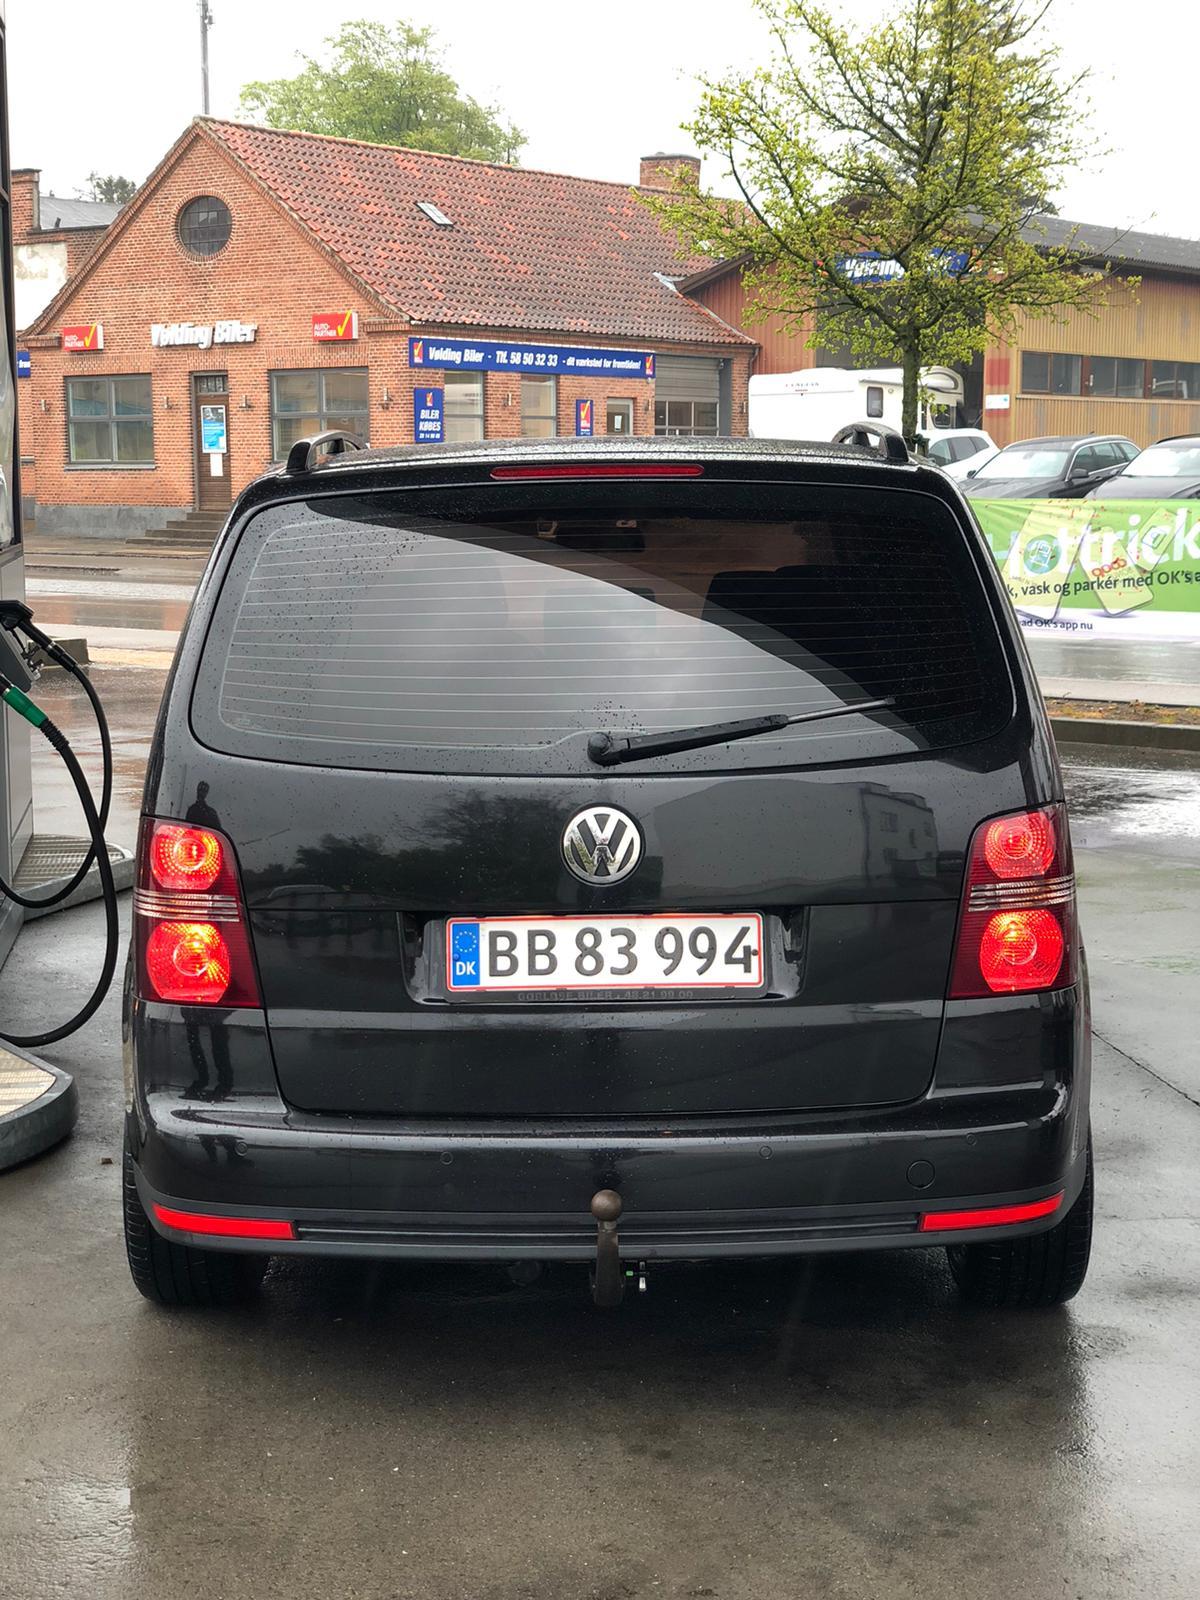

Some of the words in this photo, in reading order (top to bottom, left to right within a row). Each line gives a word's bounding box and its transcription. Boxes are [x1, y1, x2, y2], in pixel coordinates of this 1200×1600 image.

[214, 320, 259, 344] Biler
[429, 347, 462, 364] Vølding
[463, 349, 484, 362] Biler
[510, 351, 521, 364] 58
[522, 353, 534, 365] 50
[535, 354, 546, 366] 32
[547, 355, 558, 367] 33
[420, 409, 440, 419] BILER
[1021, 573, 1055, 596] vask
[1054, 579, 1071, 597] og
[1073, 572, 1119, 596] parkér
[1122, 567, 1153, 588] med
[1060, 621, 1079, 632] app
[1080, 622, 1093, 630] nu
[488, 929, 558, 977] BB
[574, 927, 638, 976] 83
[654, 926, 752, 977] 994
[456, 961, 476, 976] DK
